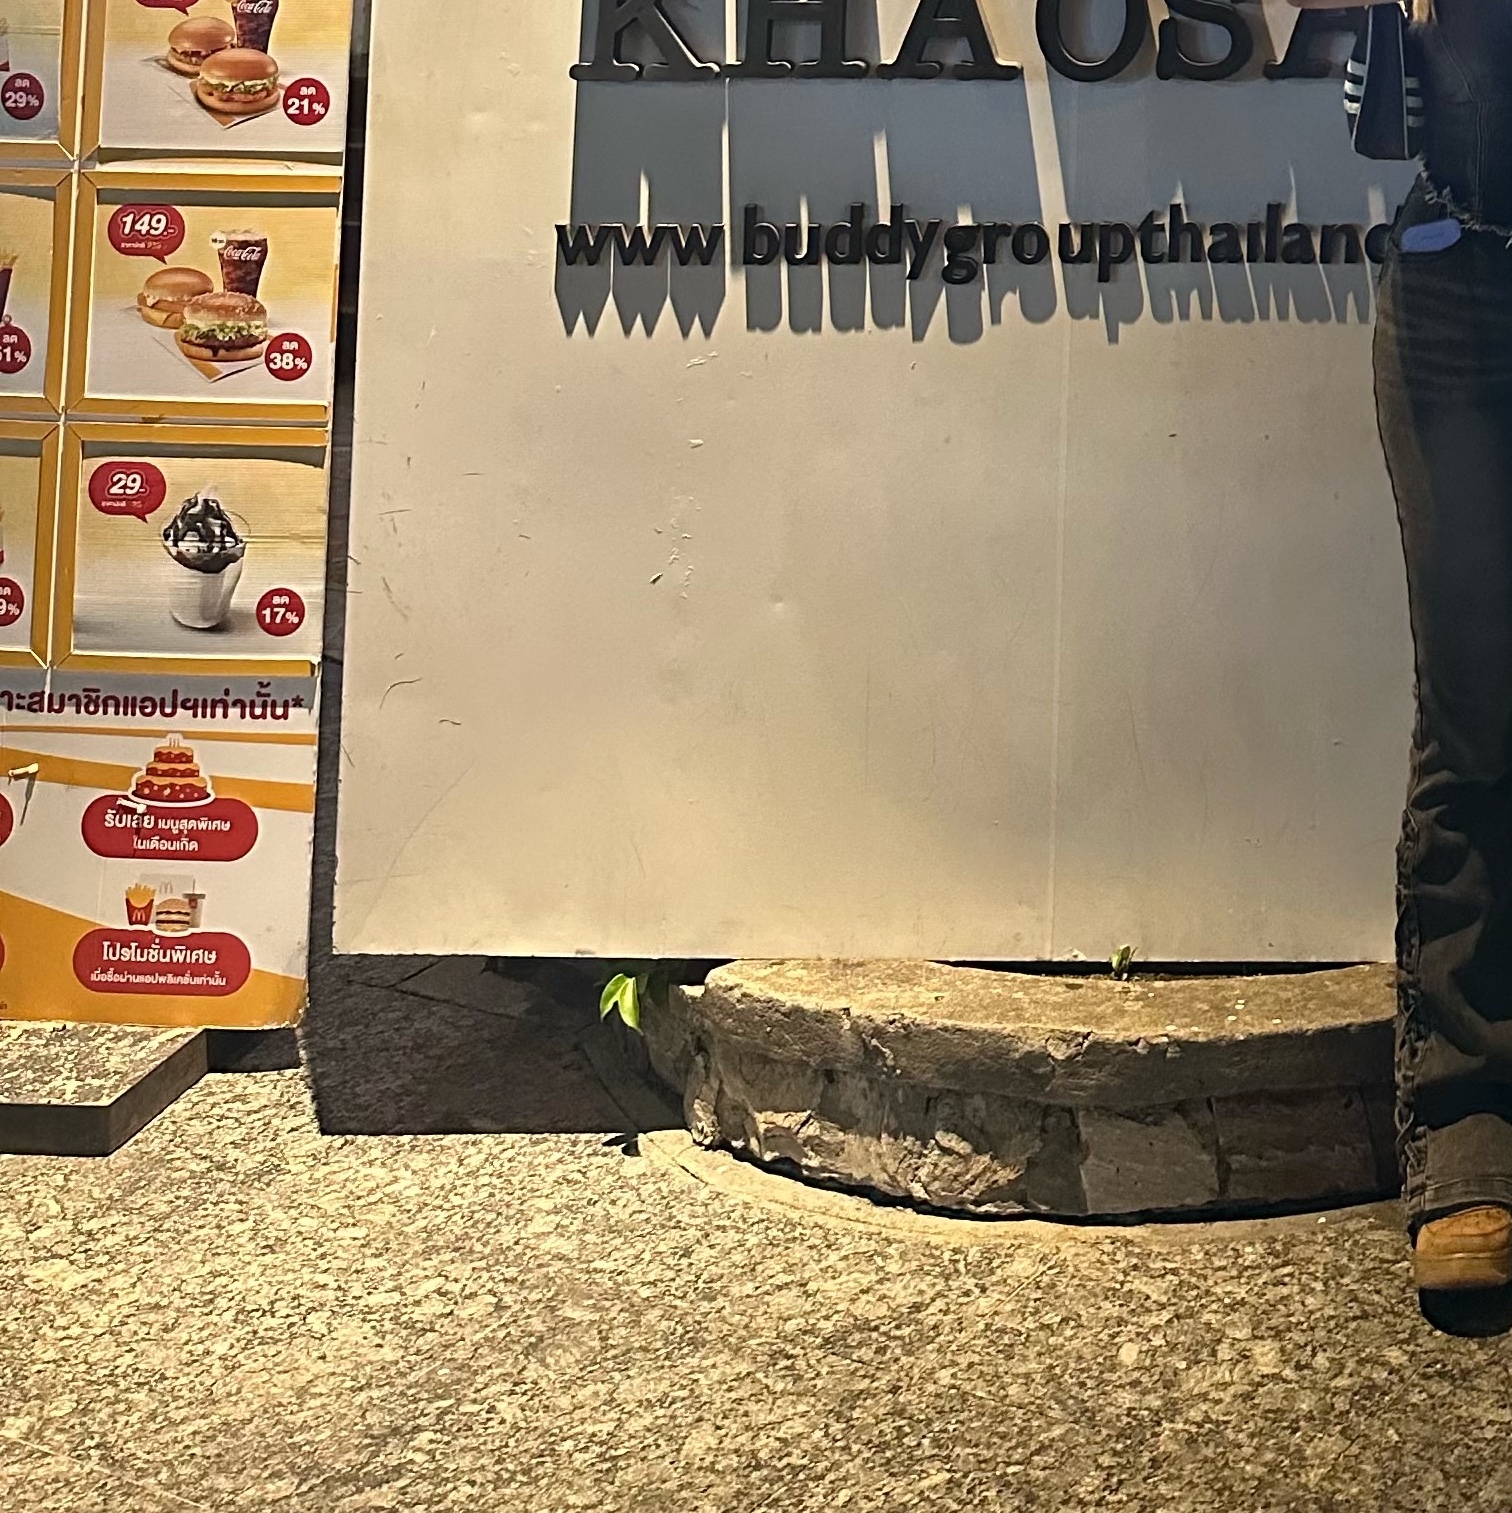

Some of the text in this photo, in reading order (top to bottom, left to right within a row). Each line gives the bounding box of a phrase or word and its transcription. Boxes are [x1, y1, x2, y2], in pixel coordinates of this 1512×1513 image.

[4, 91, 40, 109] 29%
[286, 97, 326, 116] 21%
[0, 345, 28, 363] 1%
[268, 352, 308, 371] 38%
[261, 607, 300, 625] 17%
[102, 938, 218, 964] โปรโมชั่นพิเศษ
